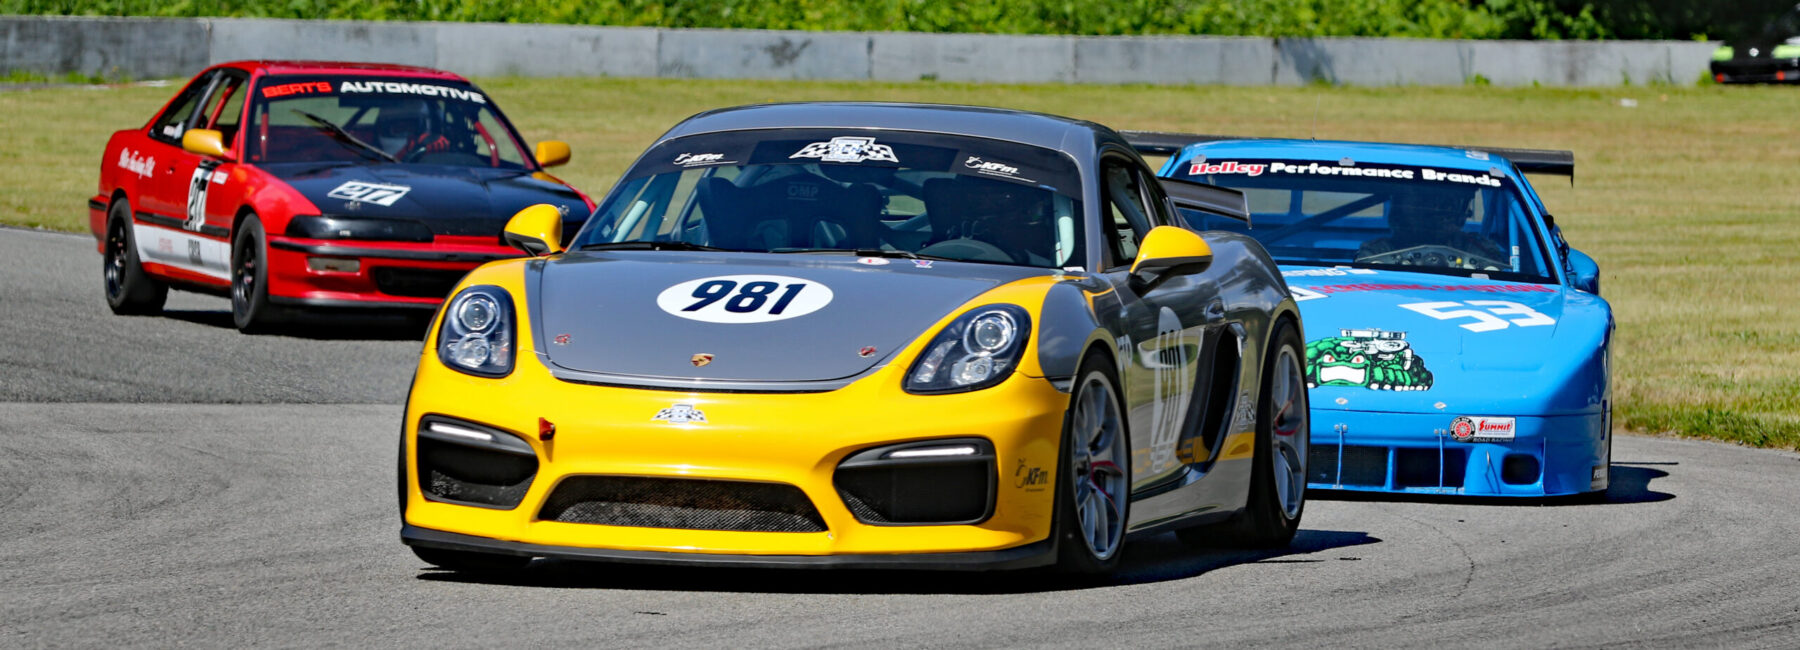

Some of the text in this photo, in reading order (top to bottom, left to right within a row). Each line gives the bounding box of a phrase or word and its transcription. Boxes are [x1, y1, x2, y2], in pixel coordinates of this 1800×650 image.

[262, 81, 487, 104] BERT'S AUTOMOTIVE
[1190, 161, 1502, 187] Holley Performance Brands
[680, 280, 807, 315] 981
[1397, 300, 1556, 332] 53
